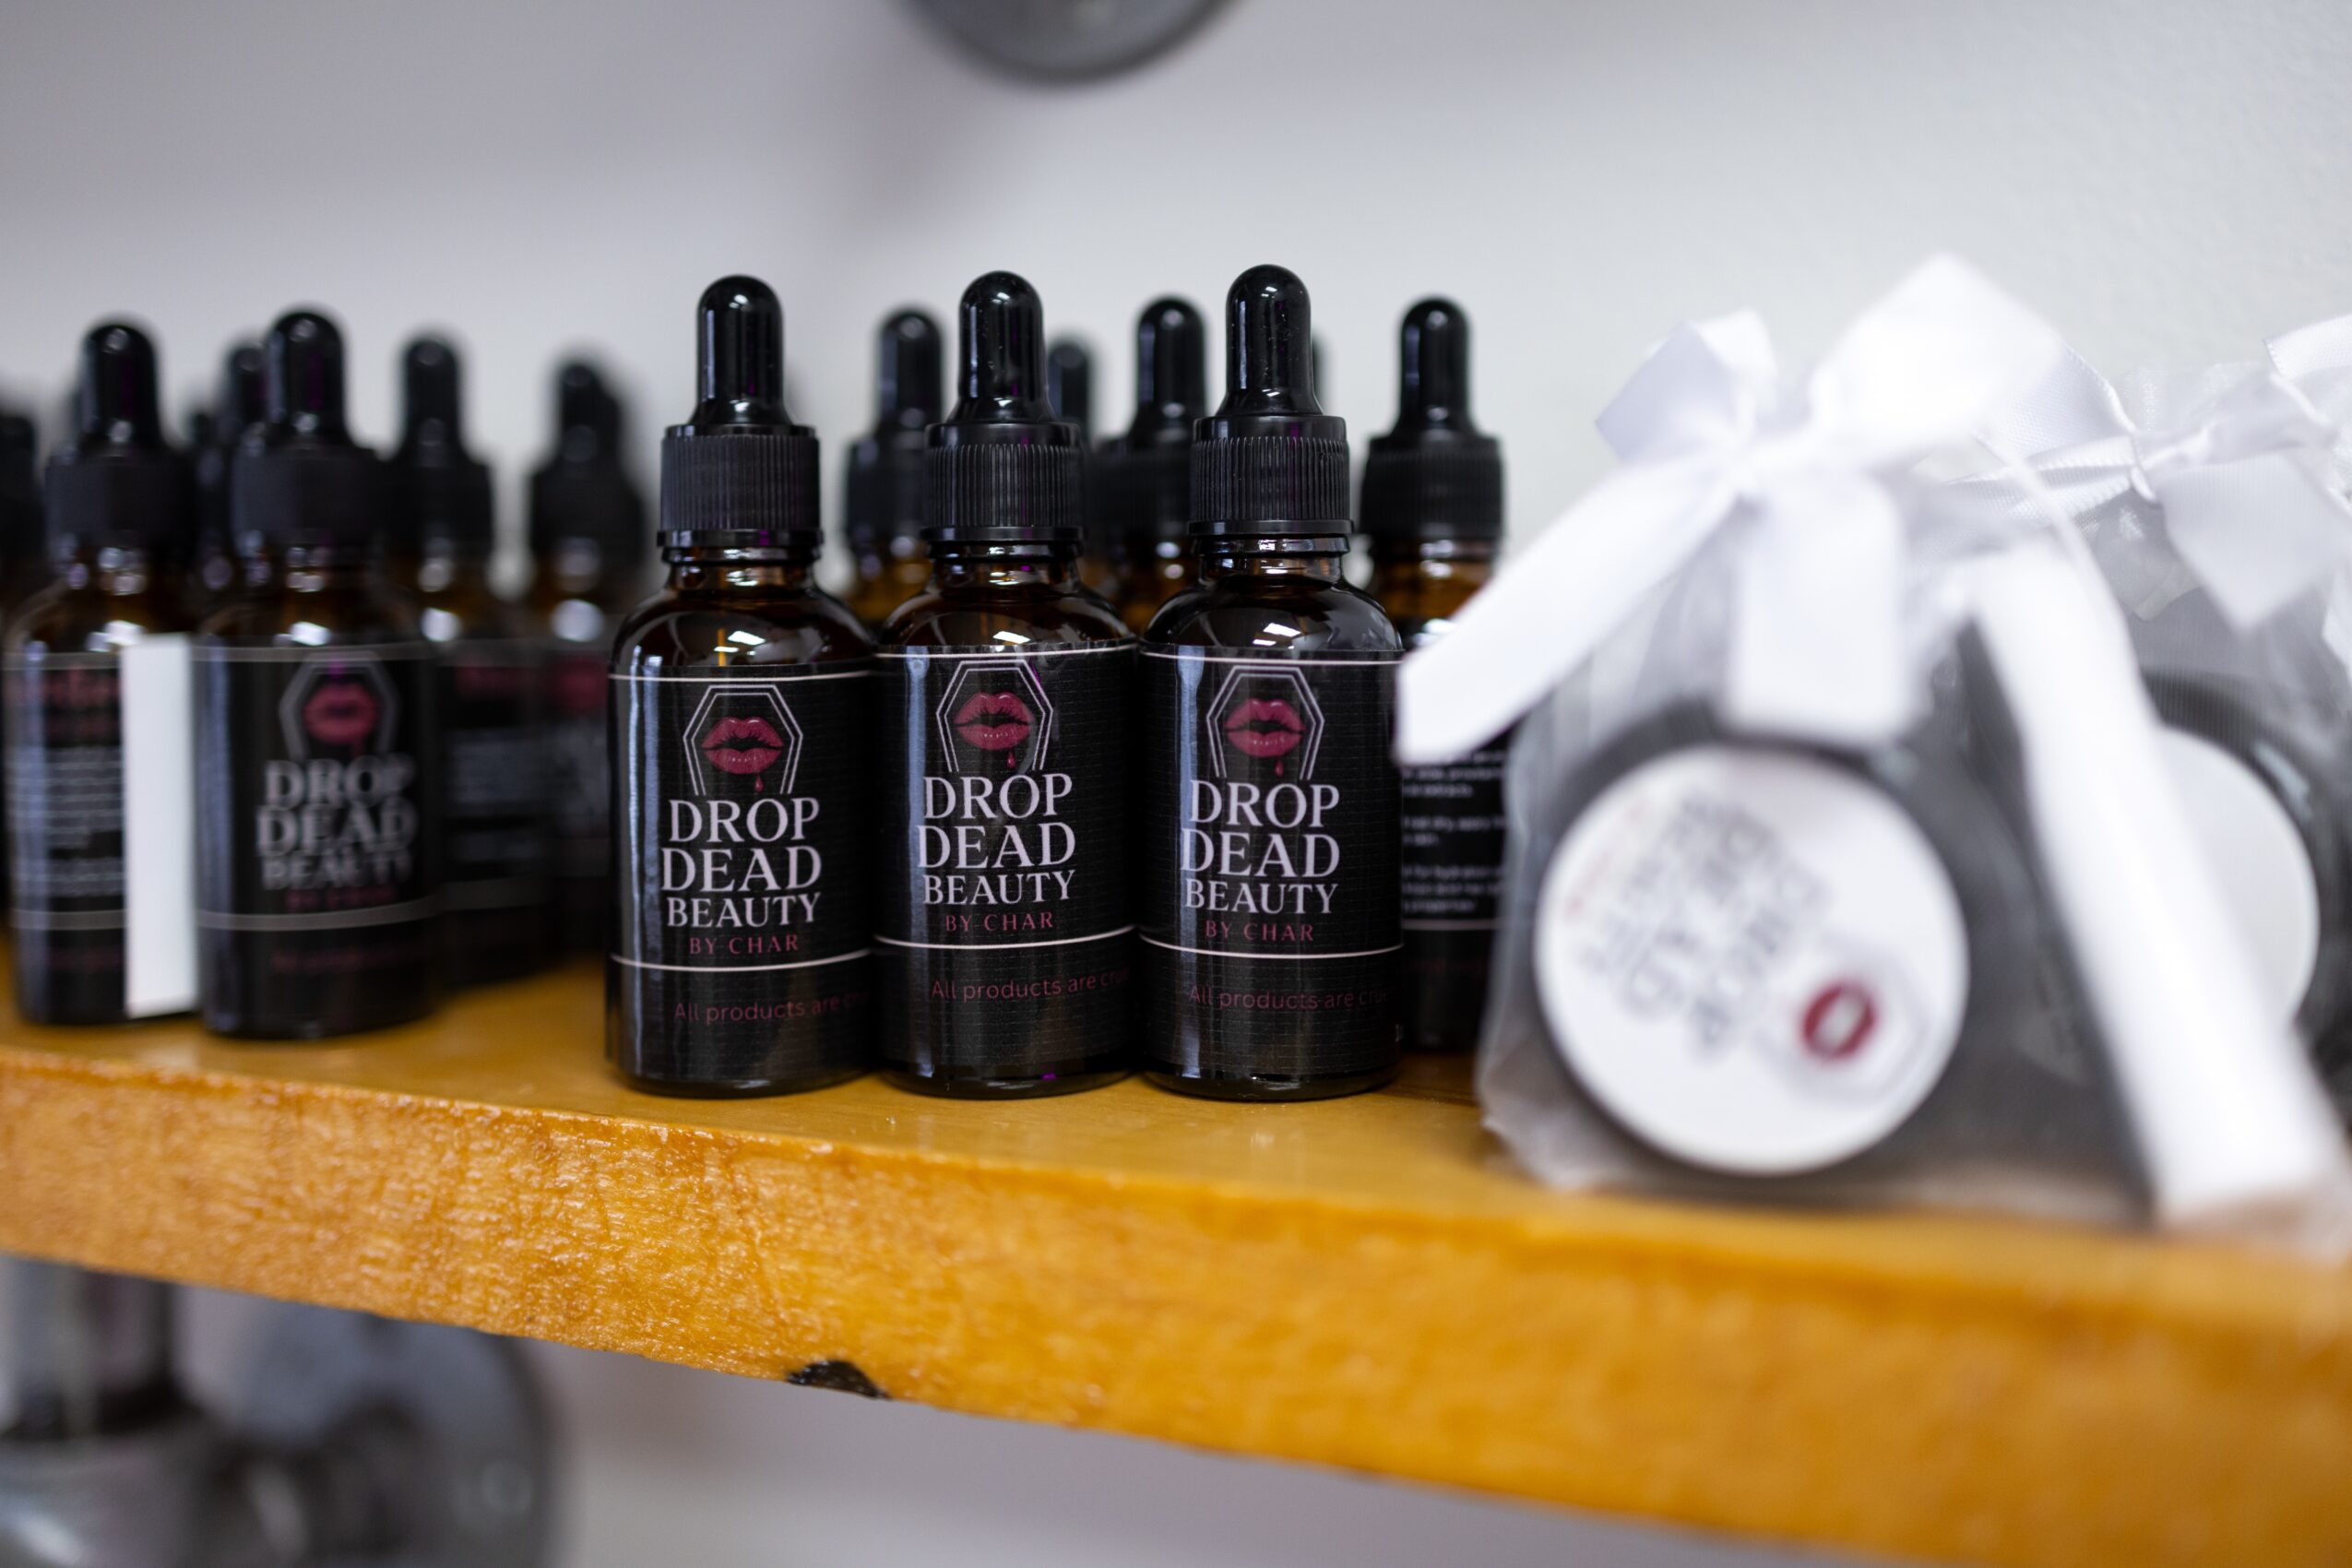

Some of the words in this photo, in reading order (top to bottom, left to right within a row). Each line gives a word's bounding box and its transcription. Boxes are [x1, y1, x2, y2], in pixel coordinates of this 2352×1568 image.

[923, 773, 1073, 819] DROP
[1190, 779, 1340, 828] DROP
[669, 797, 819, 843] DROP
[917, 822, 1075, 868] DEAD
[1180, 828, 1340, 878] DEAD
[661, 846, 822, 892] DEAD
[923, 870, 1075, 905] BEAUTY
[1185, 878, 1338, 915] BEAUTY
[667, 892, 821, 927] BEAUTY
[945, 914, 972, 932] BY
[984, 911, 1053, 931] CHAR
[690, 938, 718, 955] BY
[729, 934, 799, 955] CHAR
[1206, 921, 1232, 939] BY
[1243, 922, 1314, 942] CHAR
[931, 980, 956, 999] All
[963, 980, 1062, 1003] products
[1068, 975, 1096, 993] are
[1189, 985, 1213, 1004] All
[1219, 988, 1319, 1010] products
[1324, 992, 1354, 1007] are
[674, 1003, 699, 1021] All
[706, 1001, 805, 1026] products
[812, 995, 839, 1016] are
